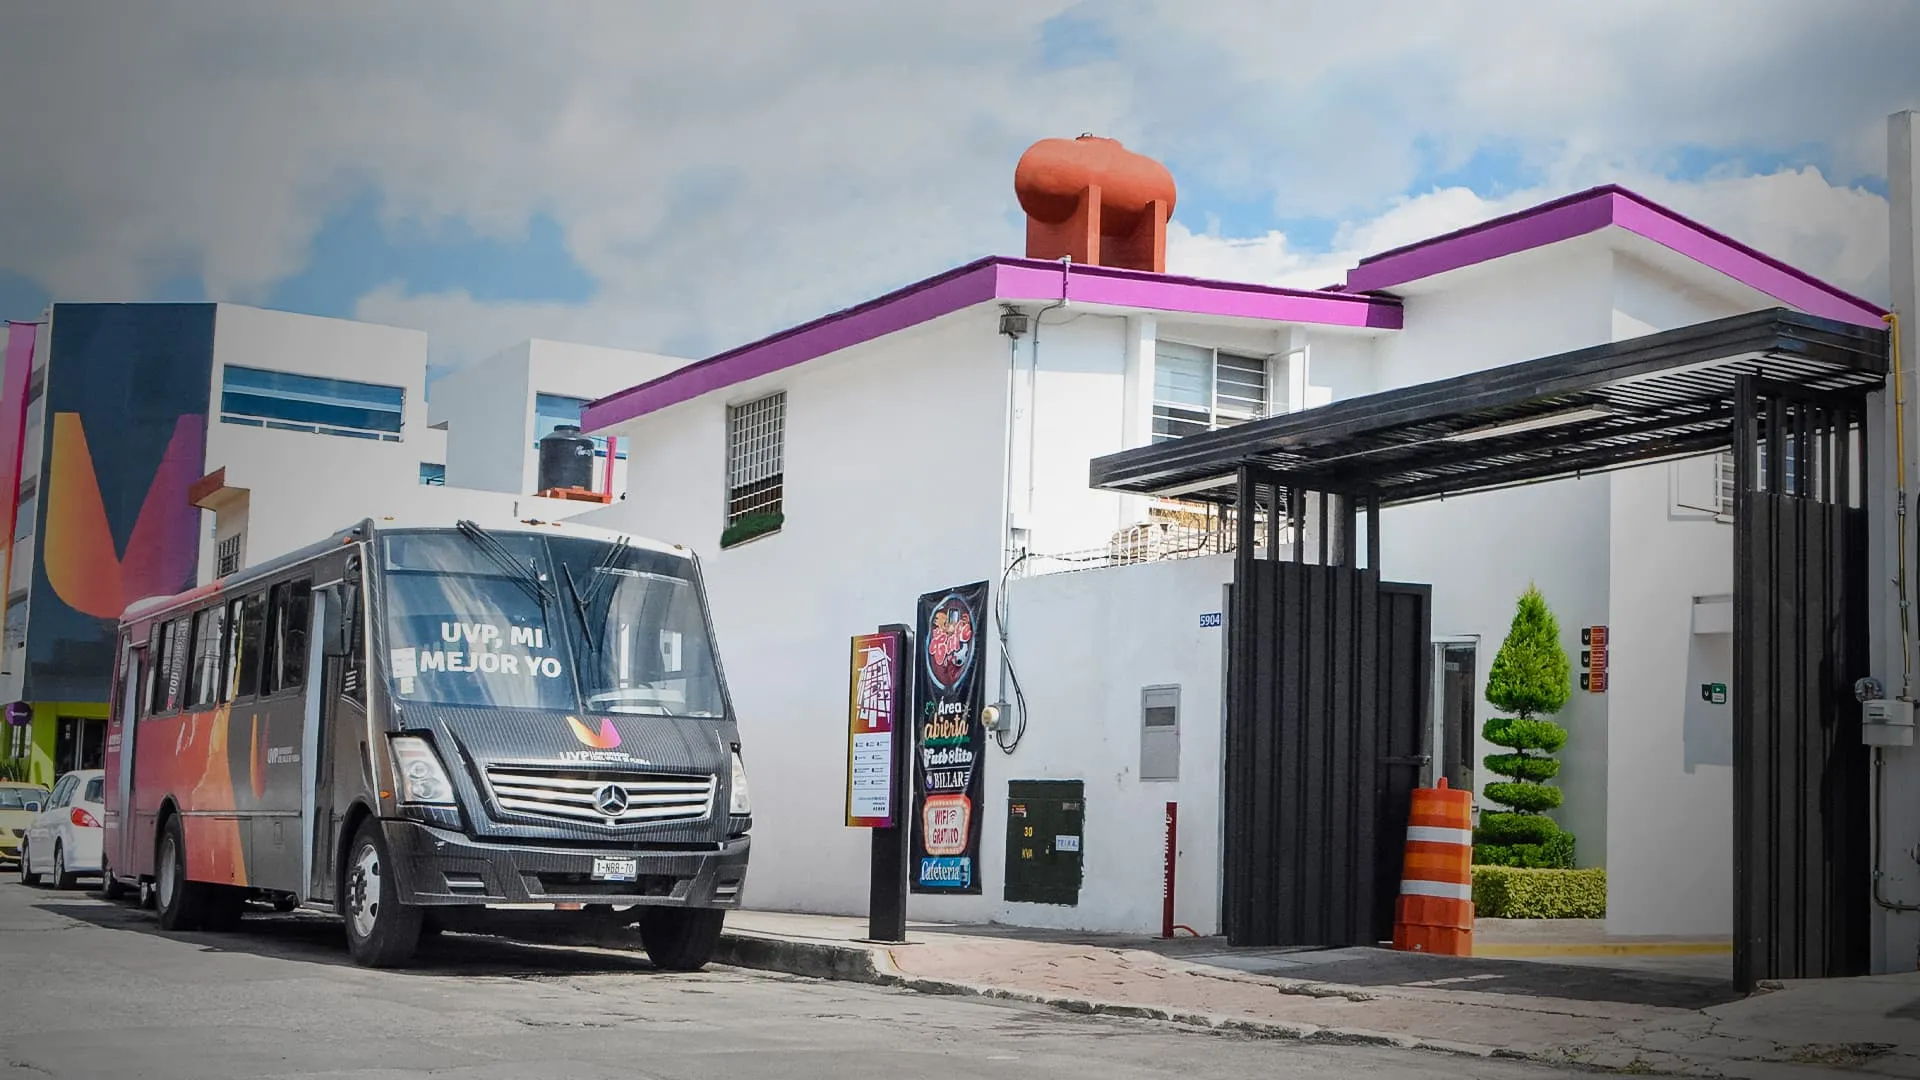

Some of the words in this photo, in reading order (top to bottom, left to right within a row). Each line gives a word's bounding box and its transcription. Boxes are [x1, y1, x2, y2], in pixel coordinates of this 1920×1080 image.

[1200, 615, 1220, 626] 5904
[441, 622, 503, 649] UVP,
[511, 627, 543, 648] MI
[420, 651, 520, 675] MEJOR
[524, 656, 562, 678] YO
[938, 695, 962, 715] Área
[924, 712, 969, 740] abierta
[559, 750, 590, 761] UVP
[933, 771, 965, 788] BILLAR
[934, 809, 949, 825] WIFI
[932, 827, 959, 844] GRATTO
[1023, 826, 1033, 838] 30
[920, 859, 961, 881] Cafetería
